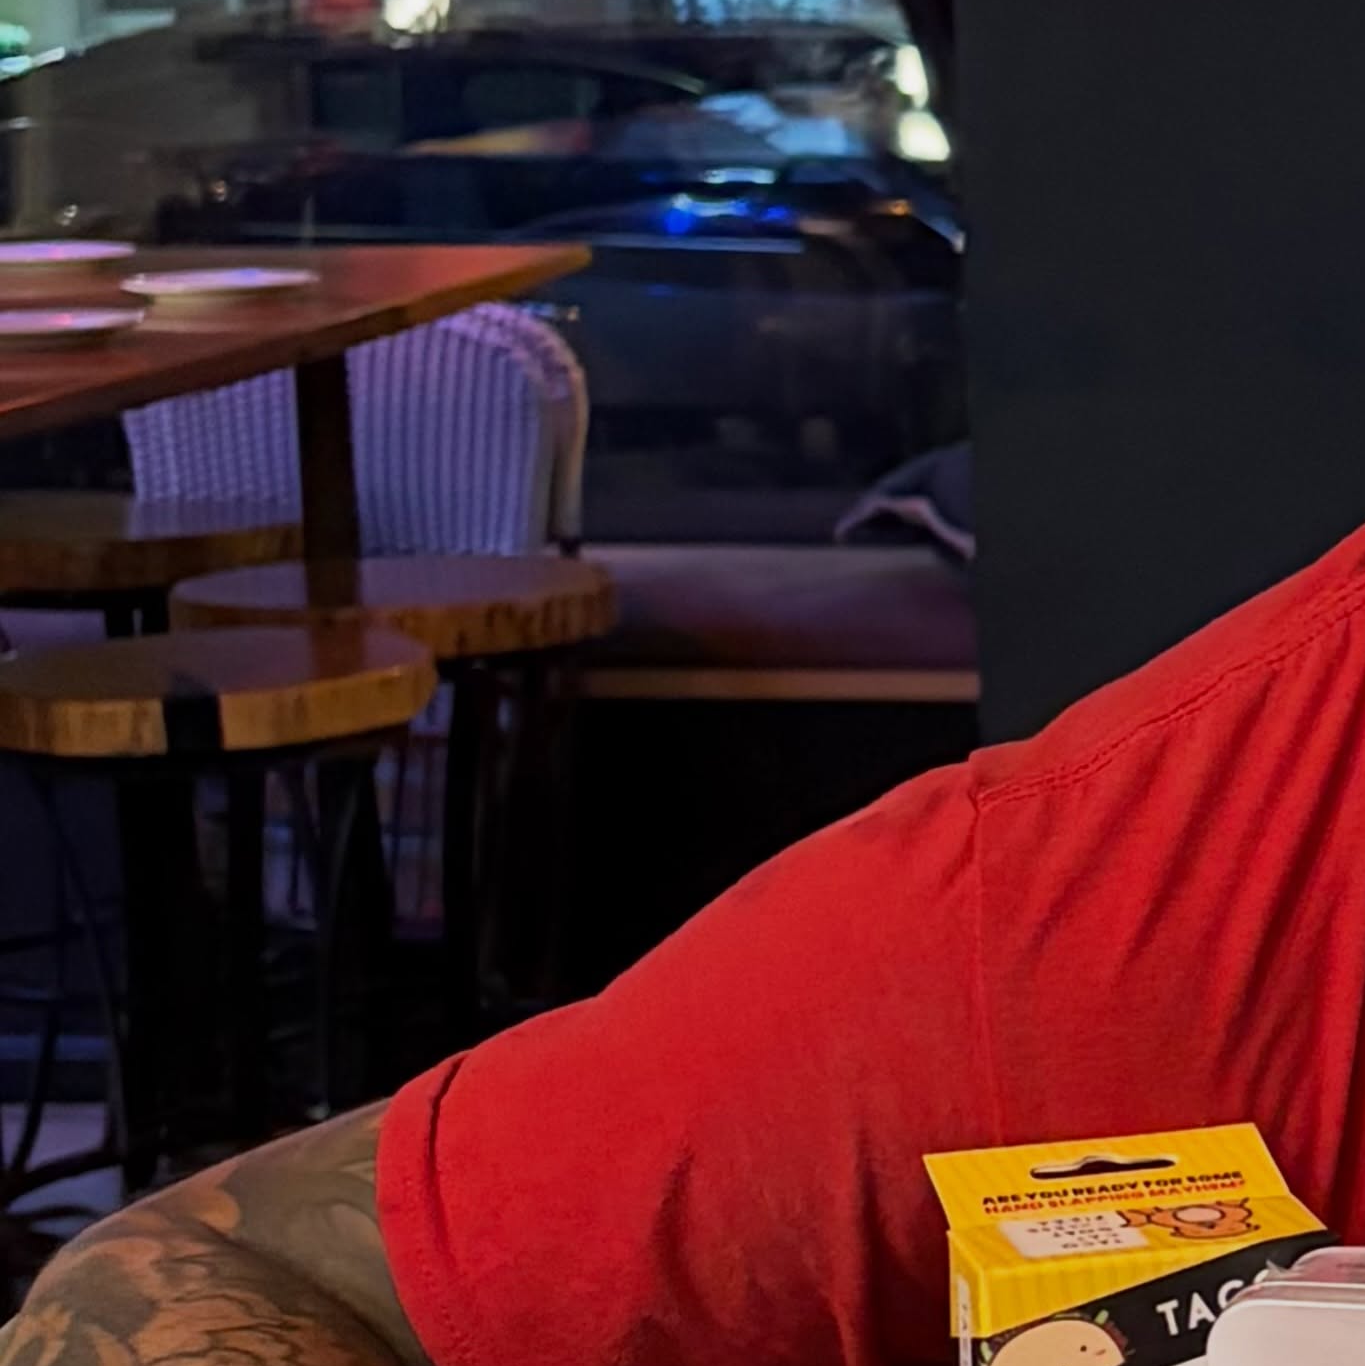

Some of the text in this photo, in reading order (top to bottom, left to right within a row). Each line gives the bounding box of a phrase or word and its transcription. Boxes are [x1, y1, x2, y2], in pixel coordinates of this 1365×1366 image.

[983, 1170, 1243, 1206] ARE YOU READY FOR SOME
[984, 1200, 1044, 1215] HAND
[1049, 1191, 1145, 1210] SLAPPING
